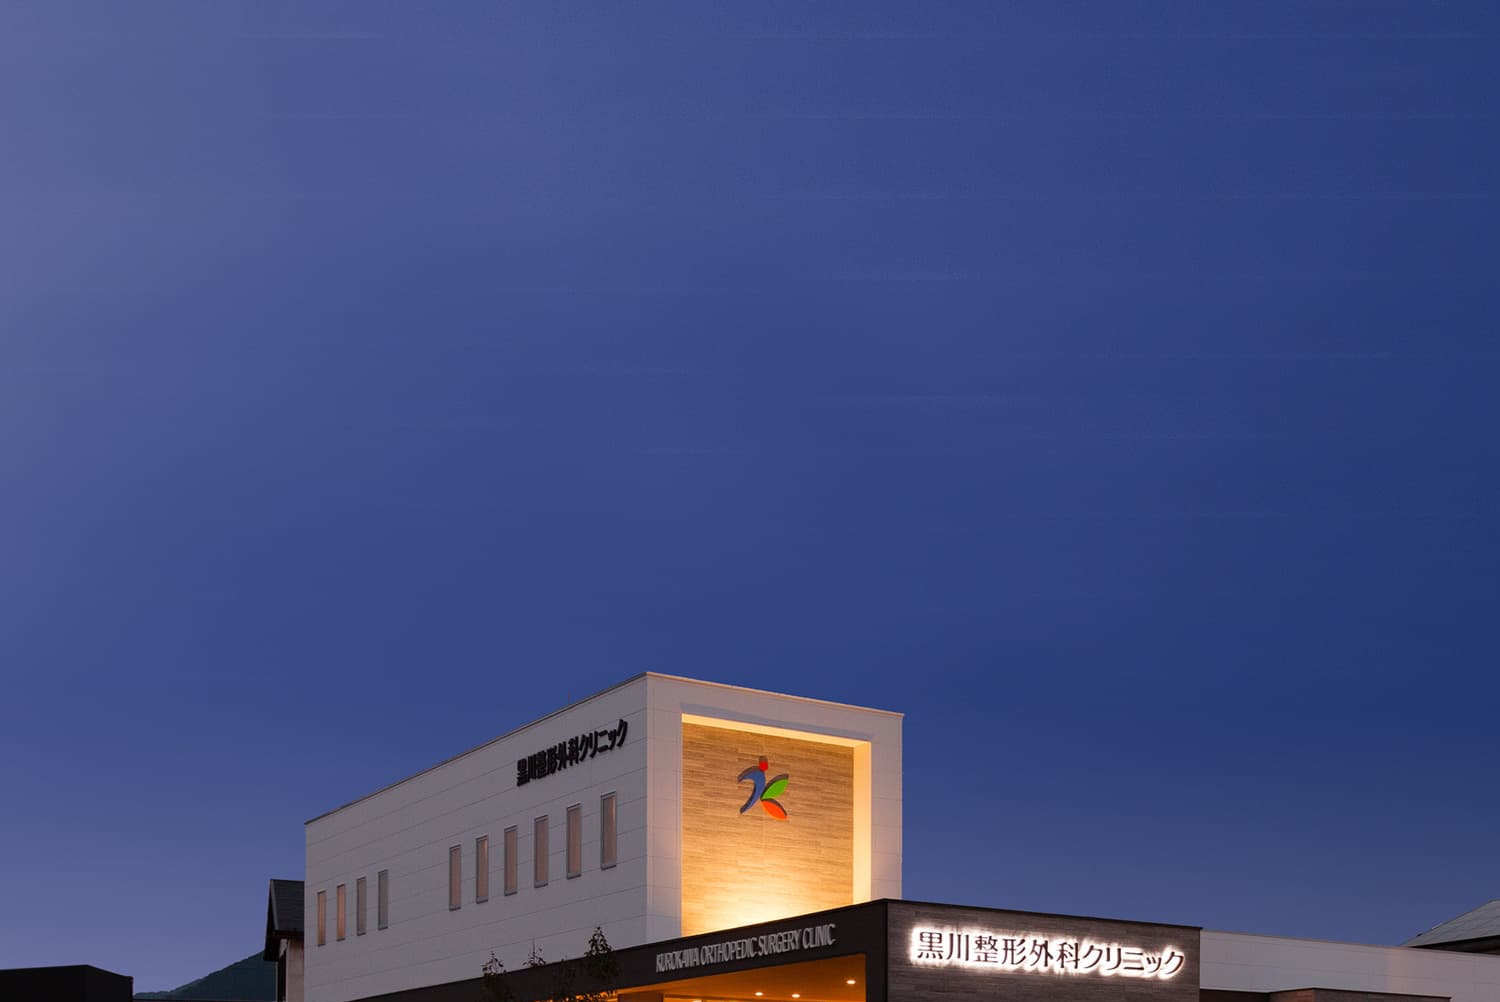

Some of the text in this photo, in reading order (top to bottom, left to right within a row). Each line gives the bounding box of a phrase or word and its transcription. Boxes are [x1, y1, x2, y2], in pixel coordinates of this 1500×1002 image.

[516, 718, 628, 787] 黒川整形外科クリニック
[655, 923, 836, 973] KUROKAWA ORTHOPEDIC SURGERY CLINIC
[916, 930, 1185, 976] 黒川整形外科クリニック
